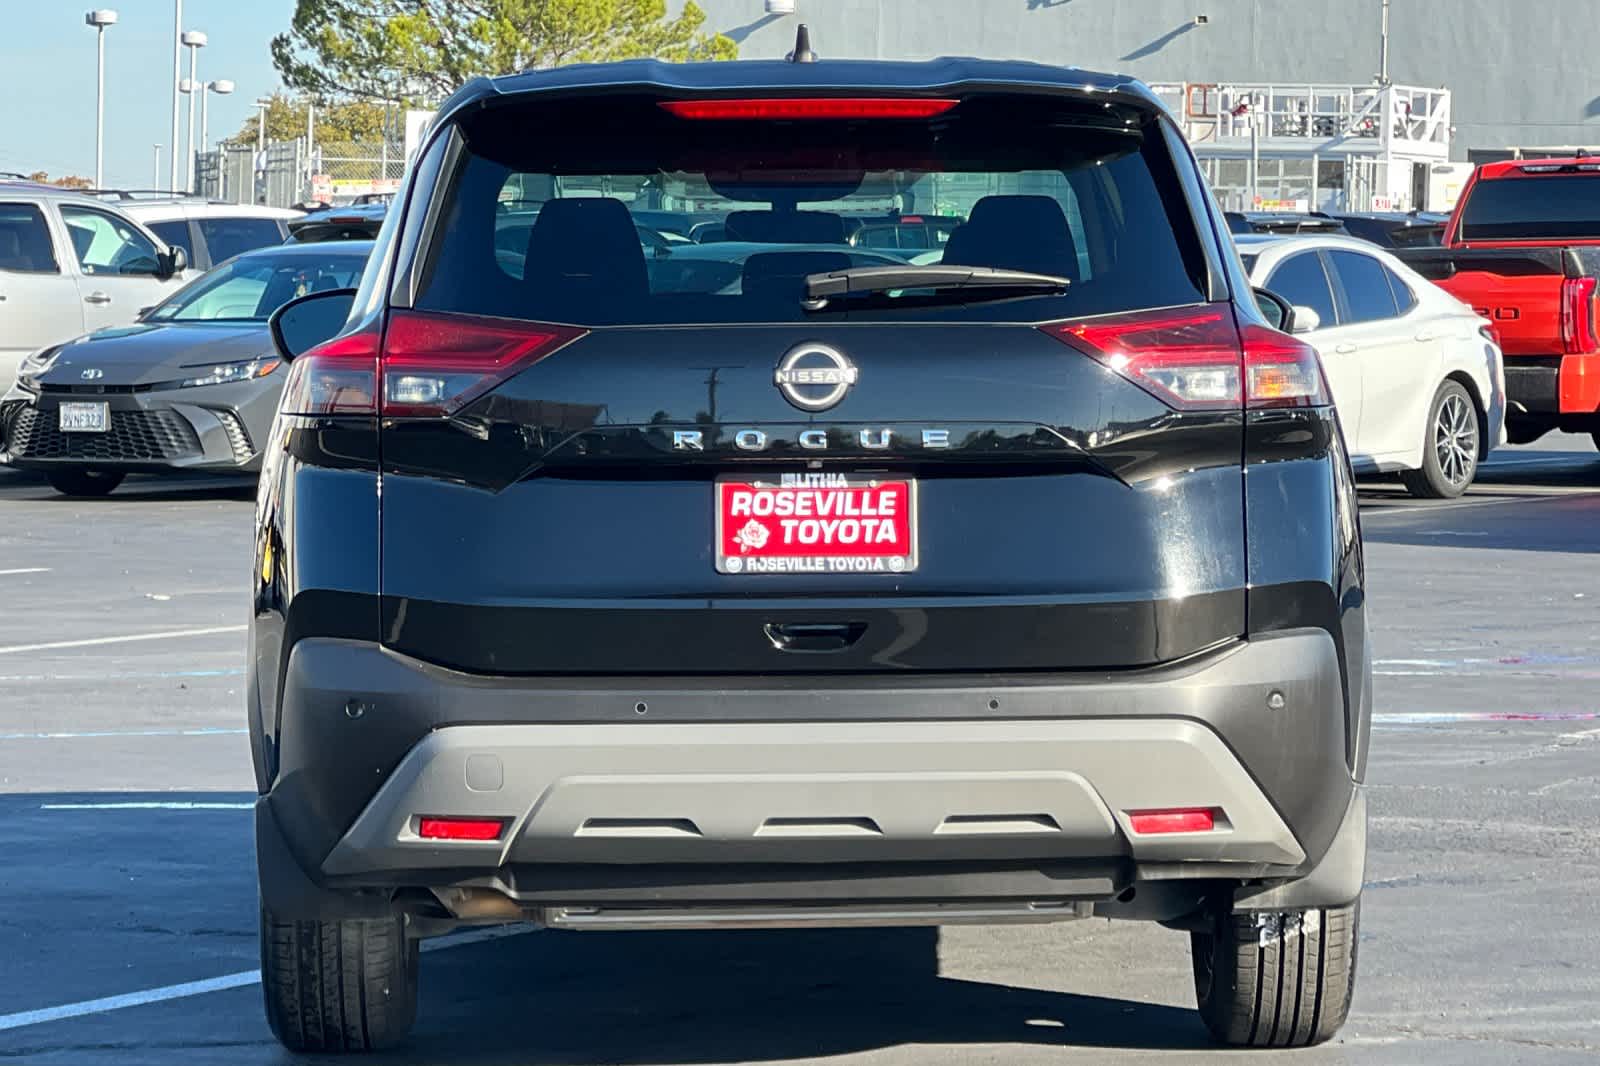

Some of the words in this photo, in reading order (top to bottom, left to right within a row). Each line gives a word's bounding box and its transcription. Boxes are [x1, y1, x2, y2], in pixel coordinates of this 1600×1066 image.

[776, 371, 855, 383] NISSAN
[673, 429, 950, 450] ROGUE
[797, 473, 849, 488] LITHIA
[731, 491, 897, 516] ROSEVILLE
[780, 519, 897, 544] TOYOTA
[747, 557, 824, 571] ROSEVILLE
[827, 557, 884, 571] TOYOTA
